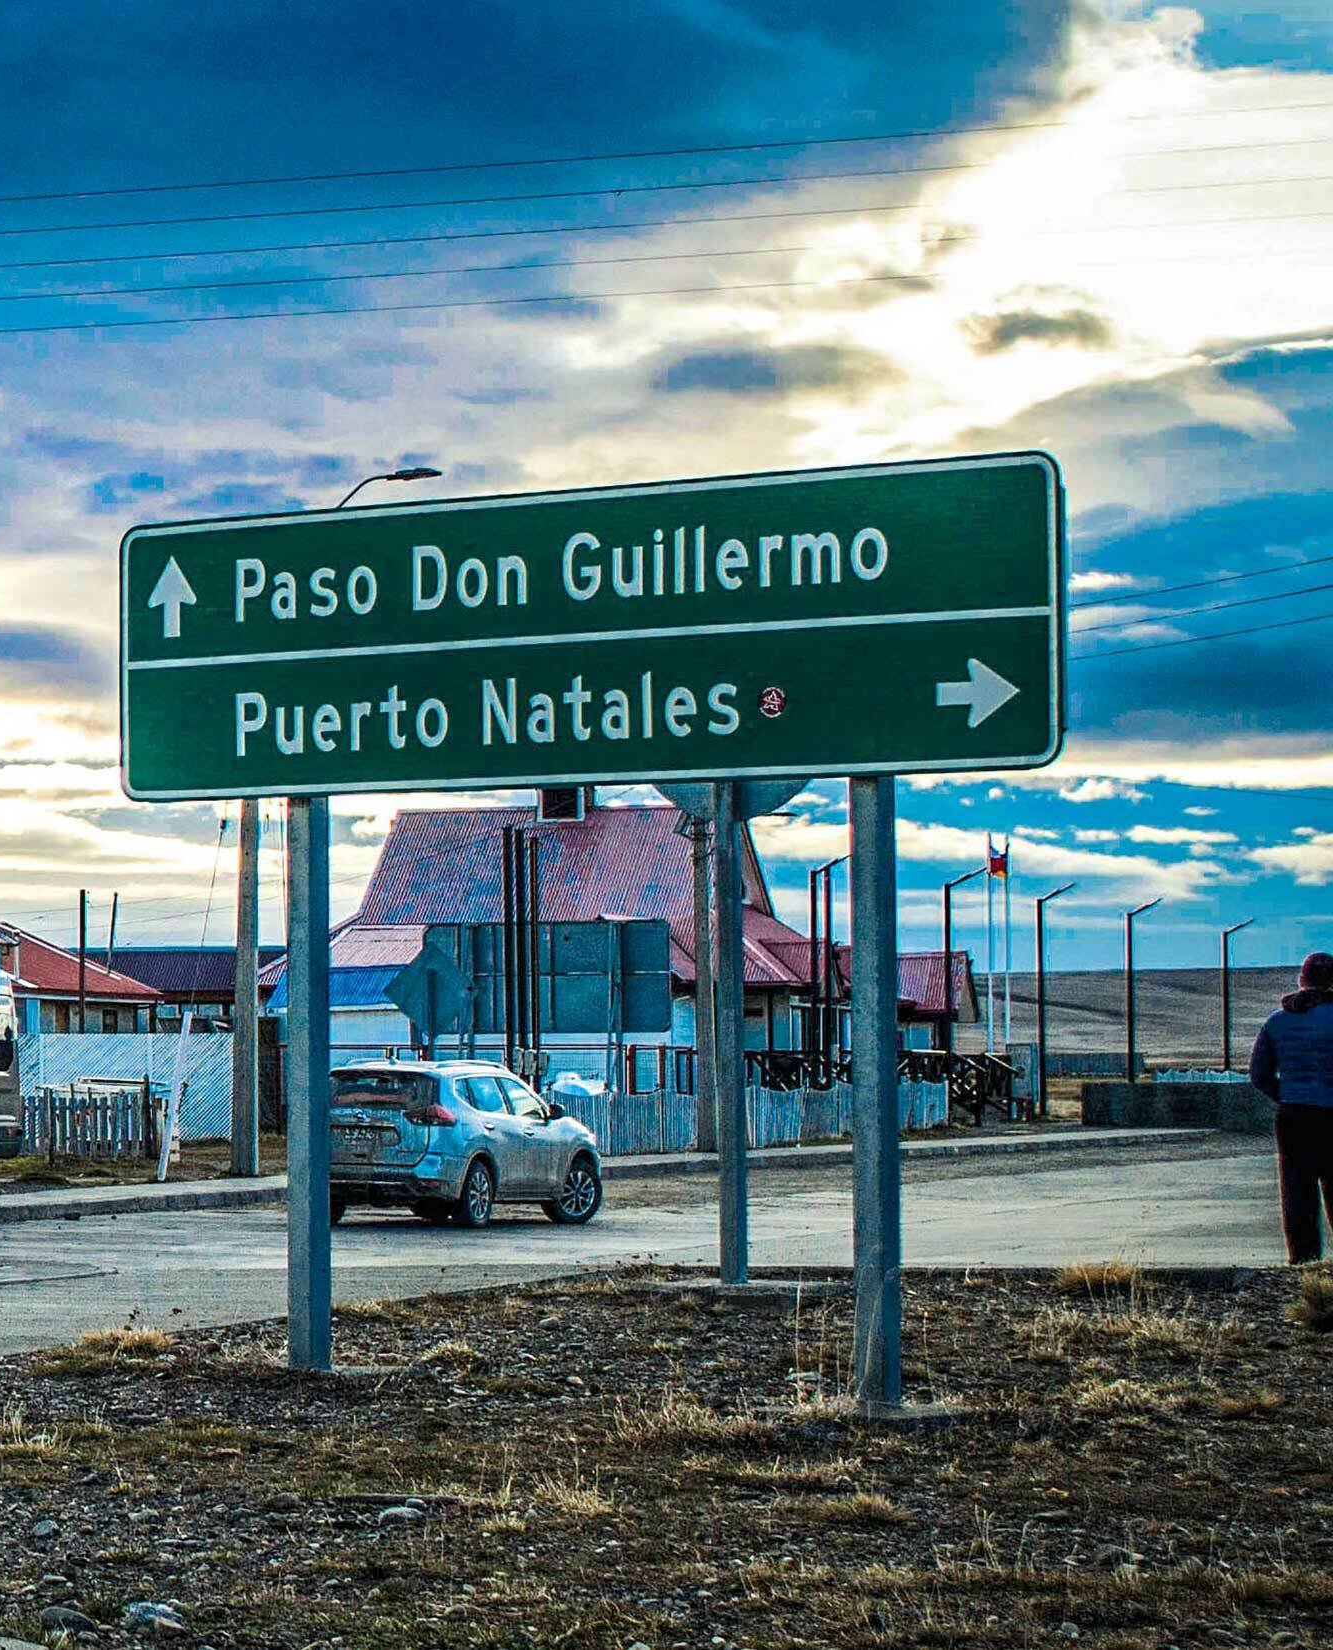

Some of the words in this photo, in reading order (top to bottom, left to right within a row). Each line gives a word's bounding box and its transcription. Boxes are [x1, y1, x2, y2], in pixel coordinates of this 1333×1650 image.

[236, 558, 377, 623] Paso
[412, 545, 528, 612] Don
[562, 525, 889, 600] Guillermo
[235, 685, 449, 757] Puerto
[482, 670, 740, 745] Natales
